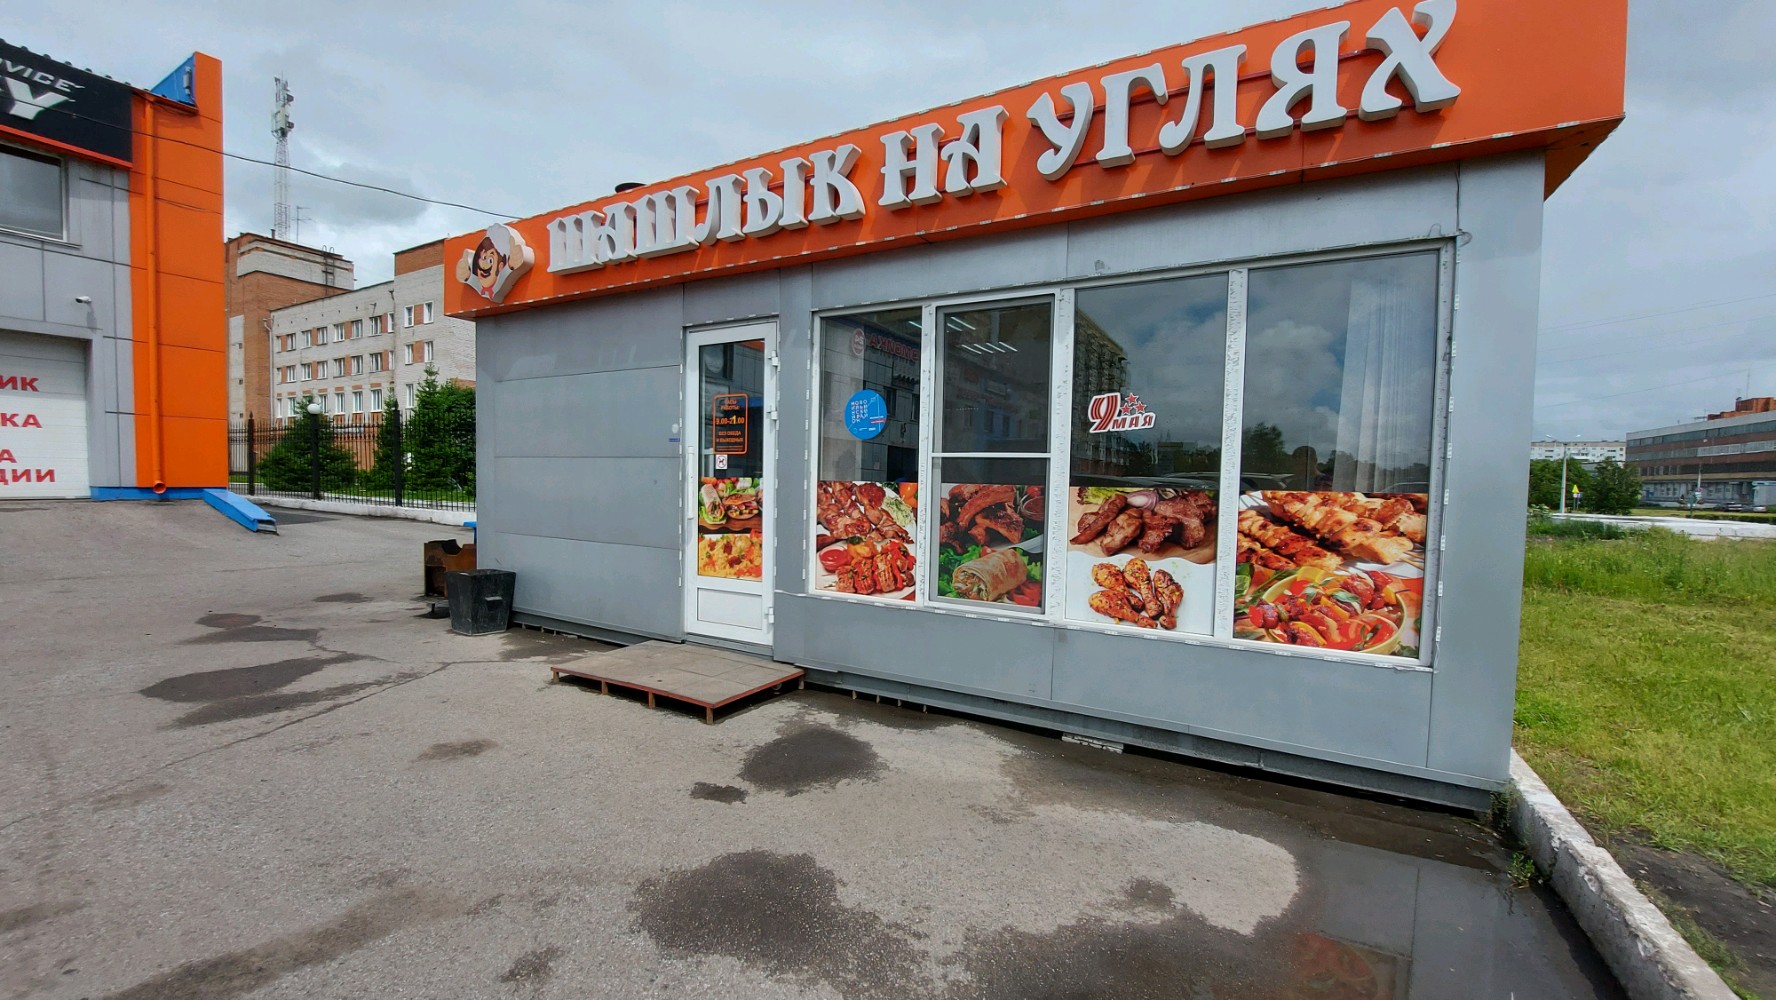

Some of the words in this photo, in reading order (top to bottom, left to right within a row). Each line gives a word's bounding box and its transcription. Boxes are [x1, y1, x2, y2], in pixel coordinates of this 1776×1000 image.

[0, 58, 78, 92] VICE
[0, 74, 70, 120] Y
[546, 143, 866, 276] ШАШЛЫК
[877, 105, 1008, 211] НА
[1026, 0, 1462, 181] УГЛЯХ
[0, 413, 42, 428] КА
[1089, 393, 1119, 432] 9
[1111, 414, 1154, 430] МАЯ
